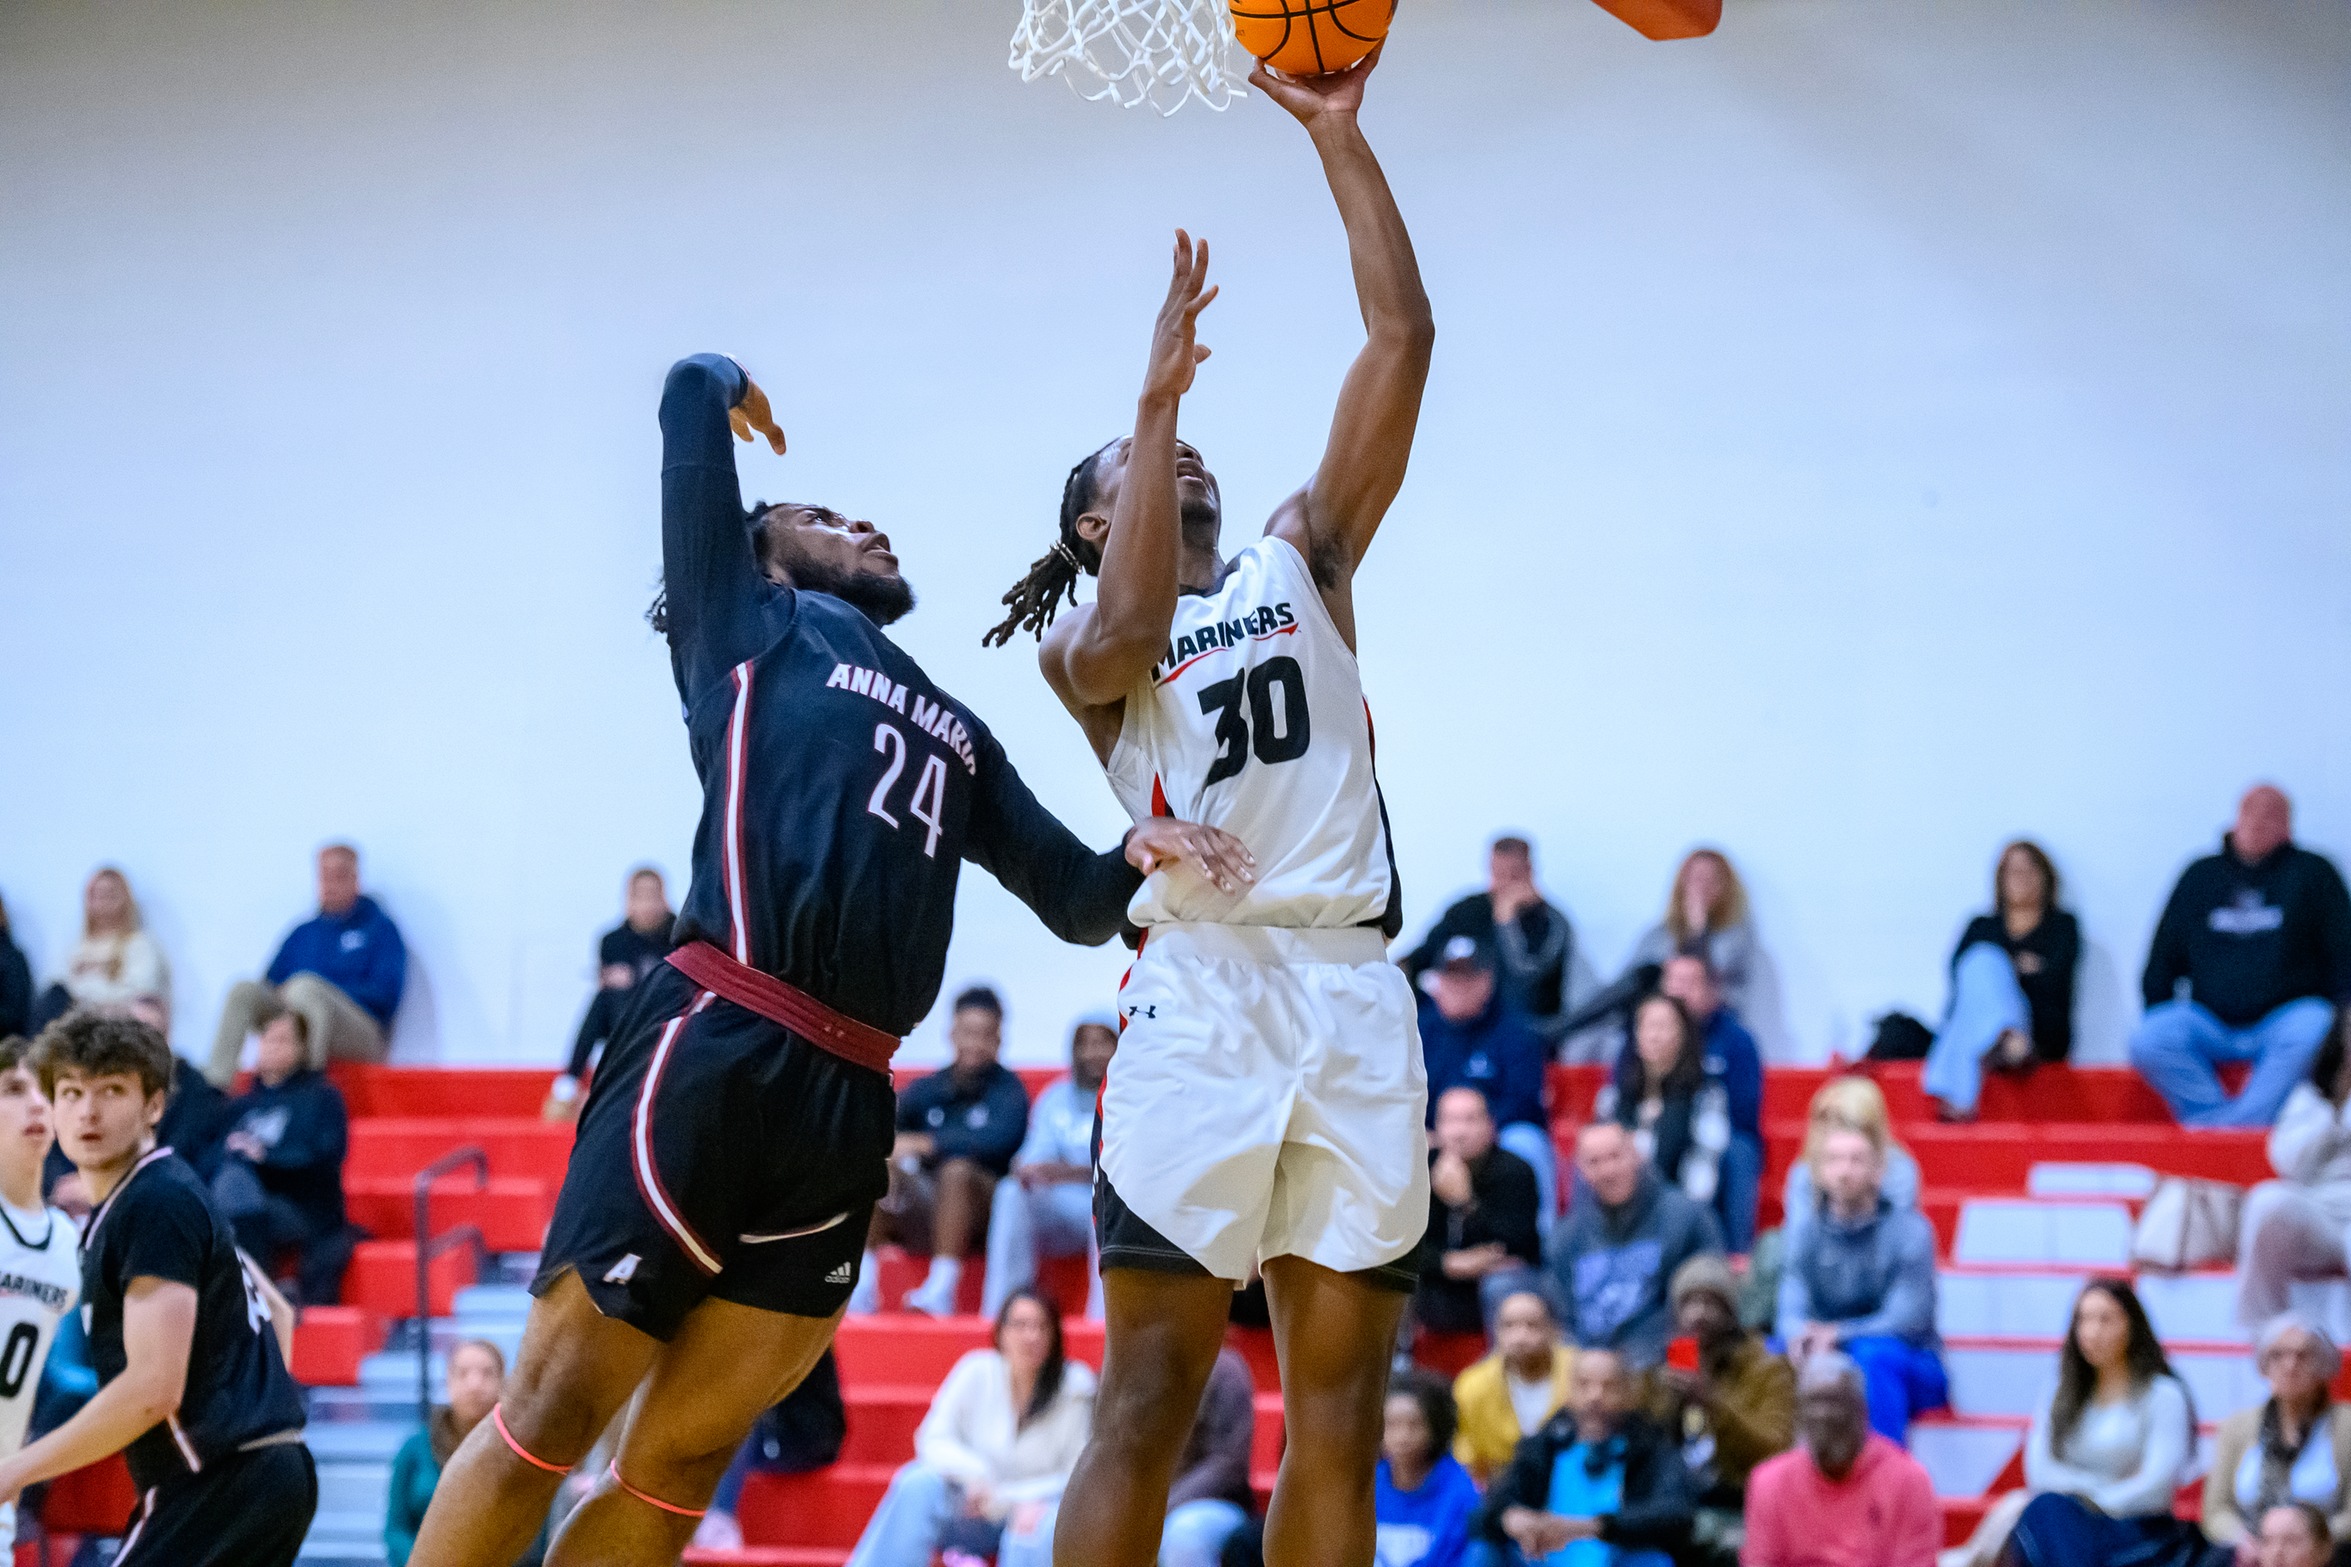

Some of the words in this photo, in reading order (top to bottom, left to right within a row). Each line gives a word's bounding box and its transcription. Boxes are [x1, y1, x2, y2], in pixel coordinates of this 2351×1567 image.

[826, 662, 909, 716] ANNA
[1197, 656, 1311, 786] 30
[867, 722, 947, 859] 24
